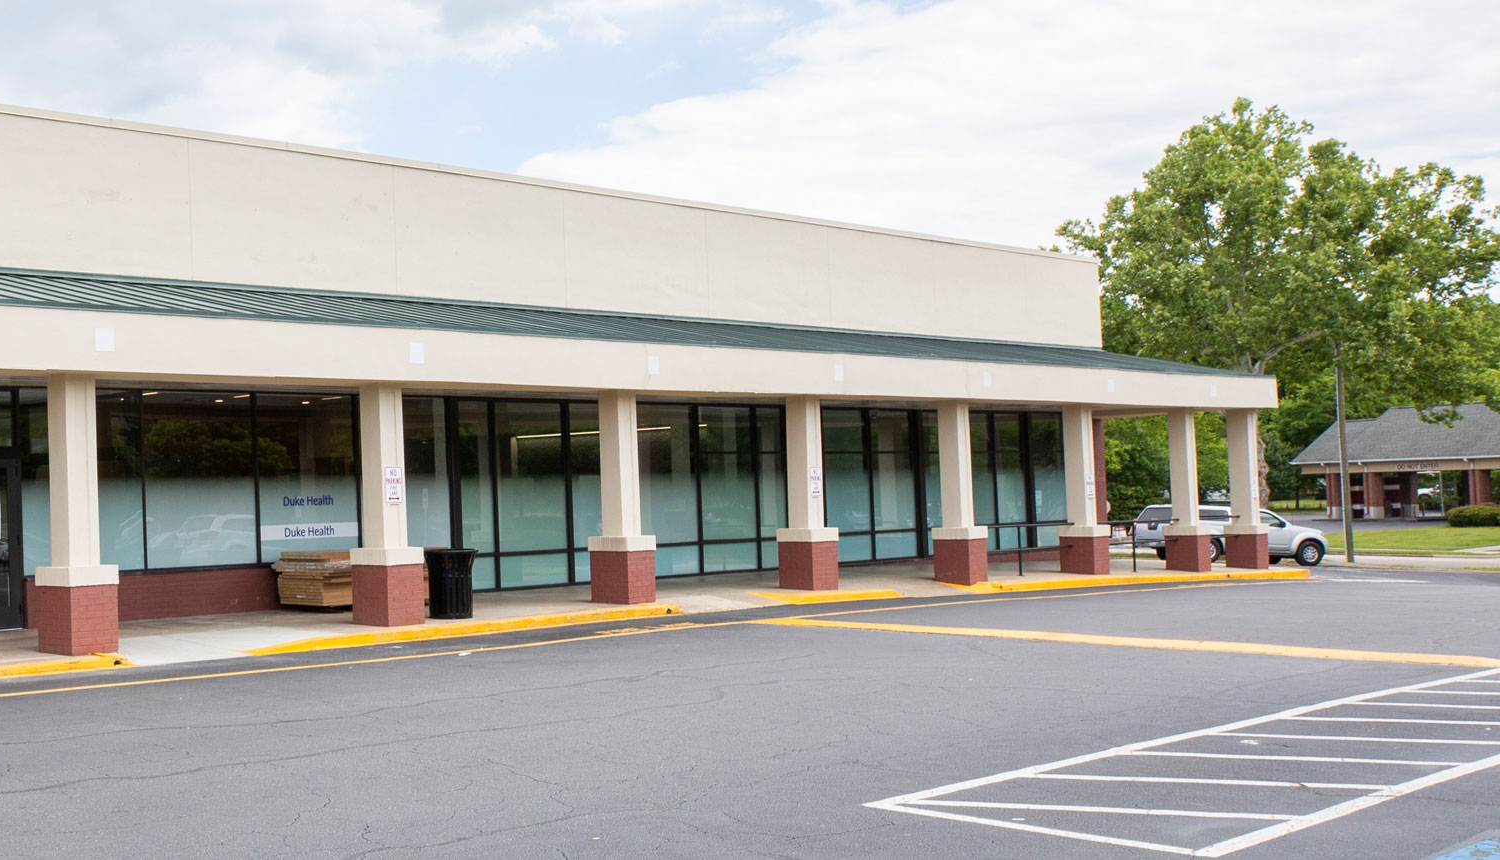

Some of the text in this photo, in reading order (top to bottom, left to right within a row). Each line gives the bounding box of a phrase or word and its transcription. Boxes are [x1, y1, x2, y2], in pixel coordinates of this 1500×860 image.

[389, 469, 398, 477] NO
[283, 495, 334, 507] Duke Health
[284, 525, 335, 538] Duke Health
